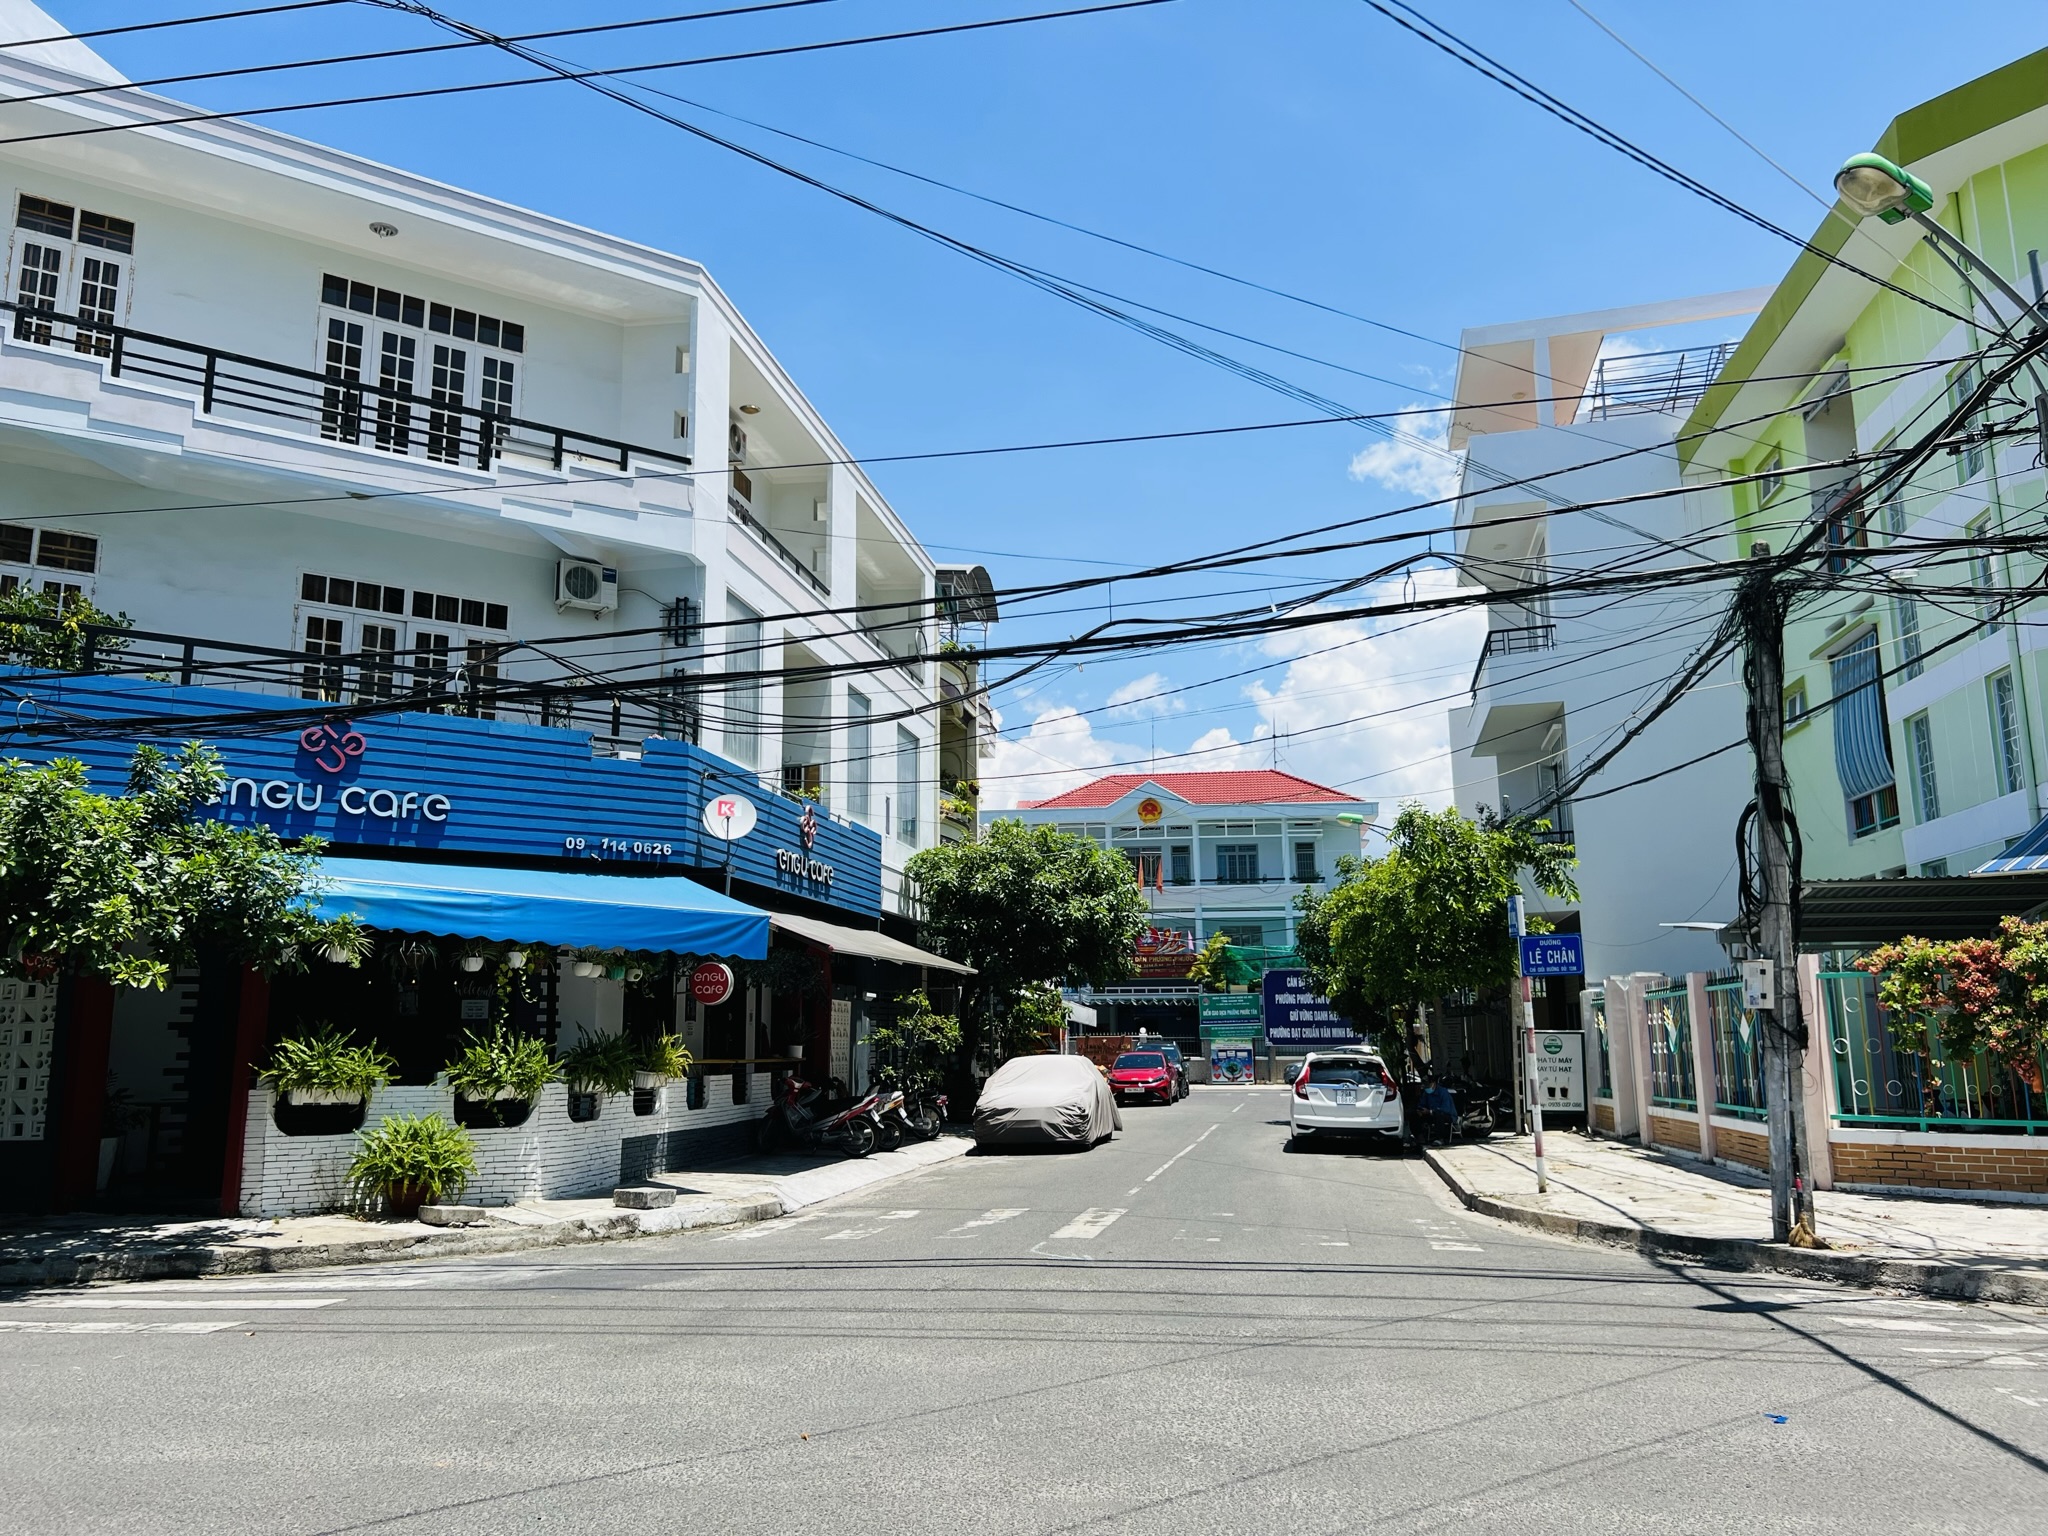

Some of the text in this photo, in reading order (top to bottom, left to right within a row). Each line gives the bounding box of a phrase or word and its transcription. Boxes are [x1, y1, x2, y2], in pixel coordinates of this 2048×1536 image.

[565, 837, 586, 850] 09
[633, 841, 673, 855] 0626
[1529, 946, 1576, 965] LÊ CHÂN
[695, 985, 724, 995] cafe
[1275, 992, 1297, 1005] PHƯỜNG
[1269, 1025, 1291, 1038] PHƯỜNG
[1557, 1056, 1573, 1064] MÁY
